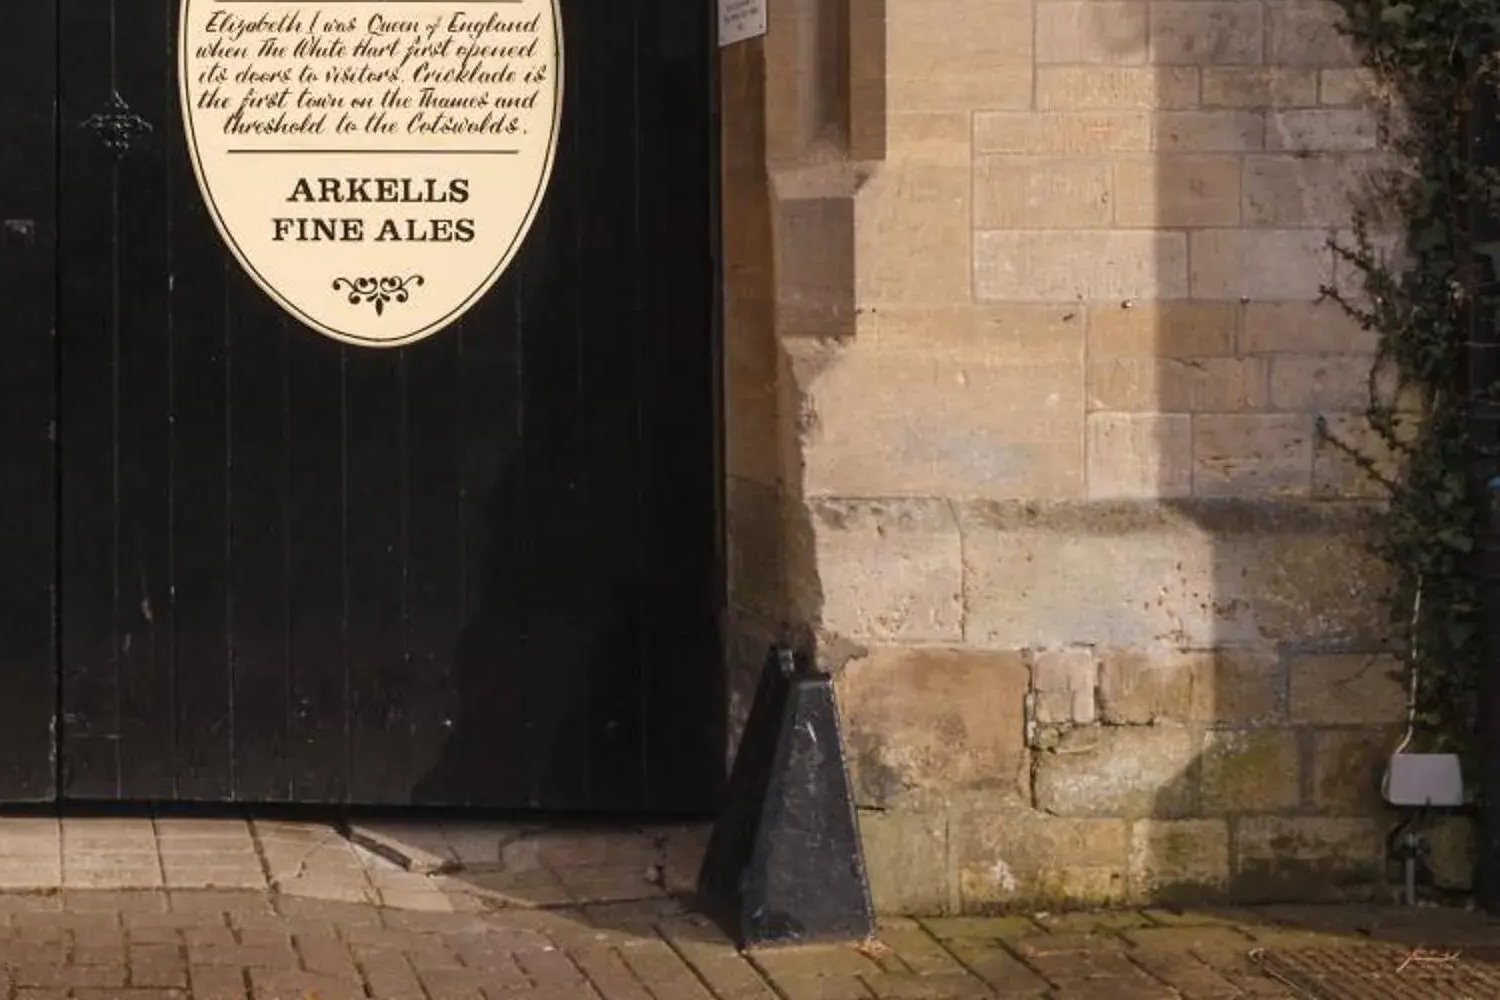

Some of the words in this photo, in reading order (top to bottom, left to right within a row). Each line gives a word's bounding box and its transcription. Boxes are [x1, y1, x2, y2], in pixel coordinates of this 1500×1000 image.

[206, 9, 302, 41] Elizabeth
[323, 17, 357, 33] was
[368, 13, 419, 36] Queen
[425, 16, 443, 40] of
[447, 12, 541, 40] England
[196, 37, 248, 59] when
[258, 37, 288, 58] The
[293, 36, 347, 58] White
[353, 37, 400, 57] Hart
[399, 34, 453, 67] first
[456, 37, 538, 68] opened
[198, 62, 228, 83] its
[236, 64, 292, 83] doors
[299, 65, 318, 82] to
[413, 60, 516, 83] Cricklade
[524, 64, 547, 83] is
[197, 87, 230, 109] the
[236, 88, 292, 113] first
[297, 88, 344, 108] town
[351, 96, 373, 108] on
[381, 87, 413, 108] the
[419, 88, 489, 108] Thames
[495, 89, 539, 108] and
[224, 112, 327, 134] threshold
[335, 112, 357, 134] to
[365, 112, 398, 133] the
[286, 178, 469, 203] ARKELLS
[272, 219, 363, 242] FINE
[375, 219, 476, 242] ALES
